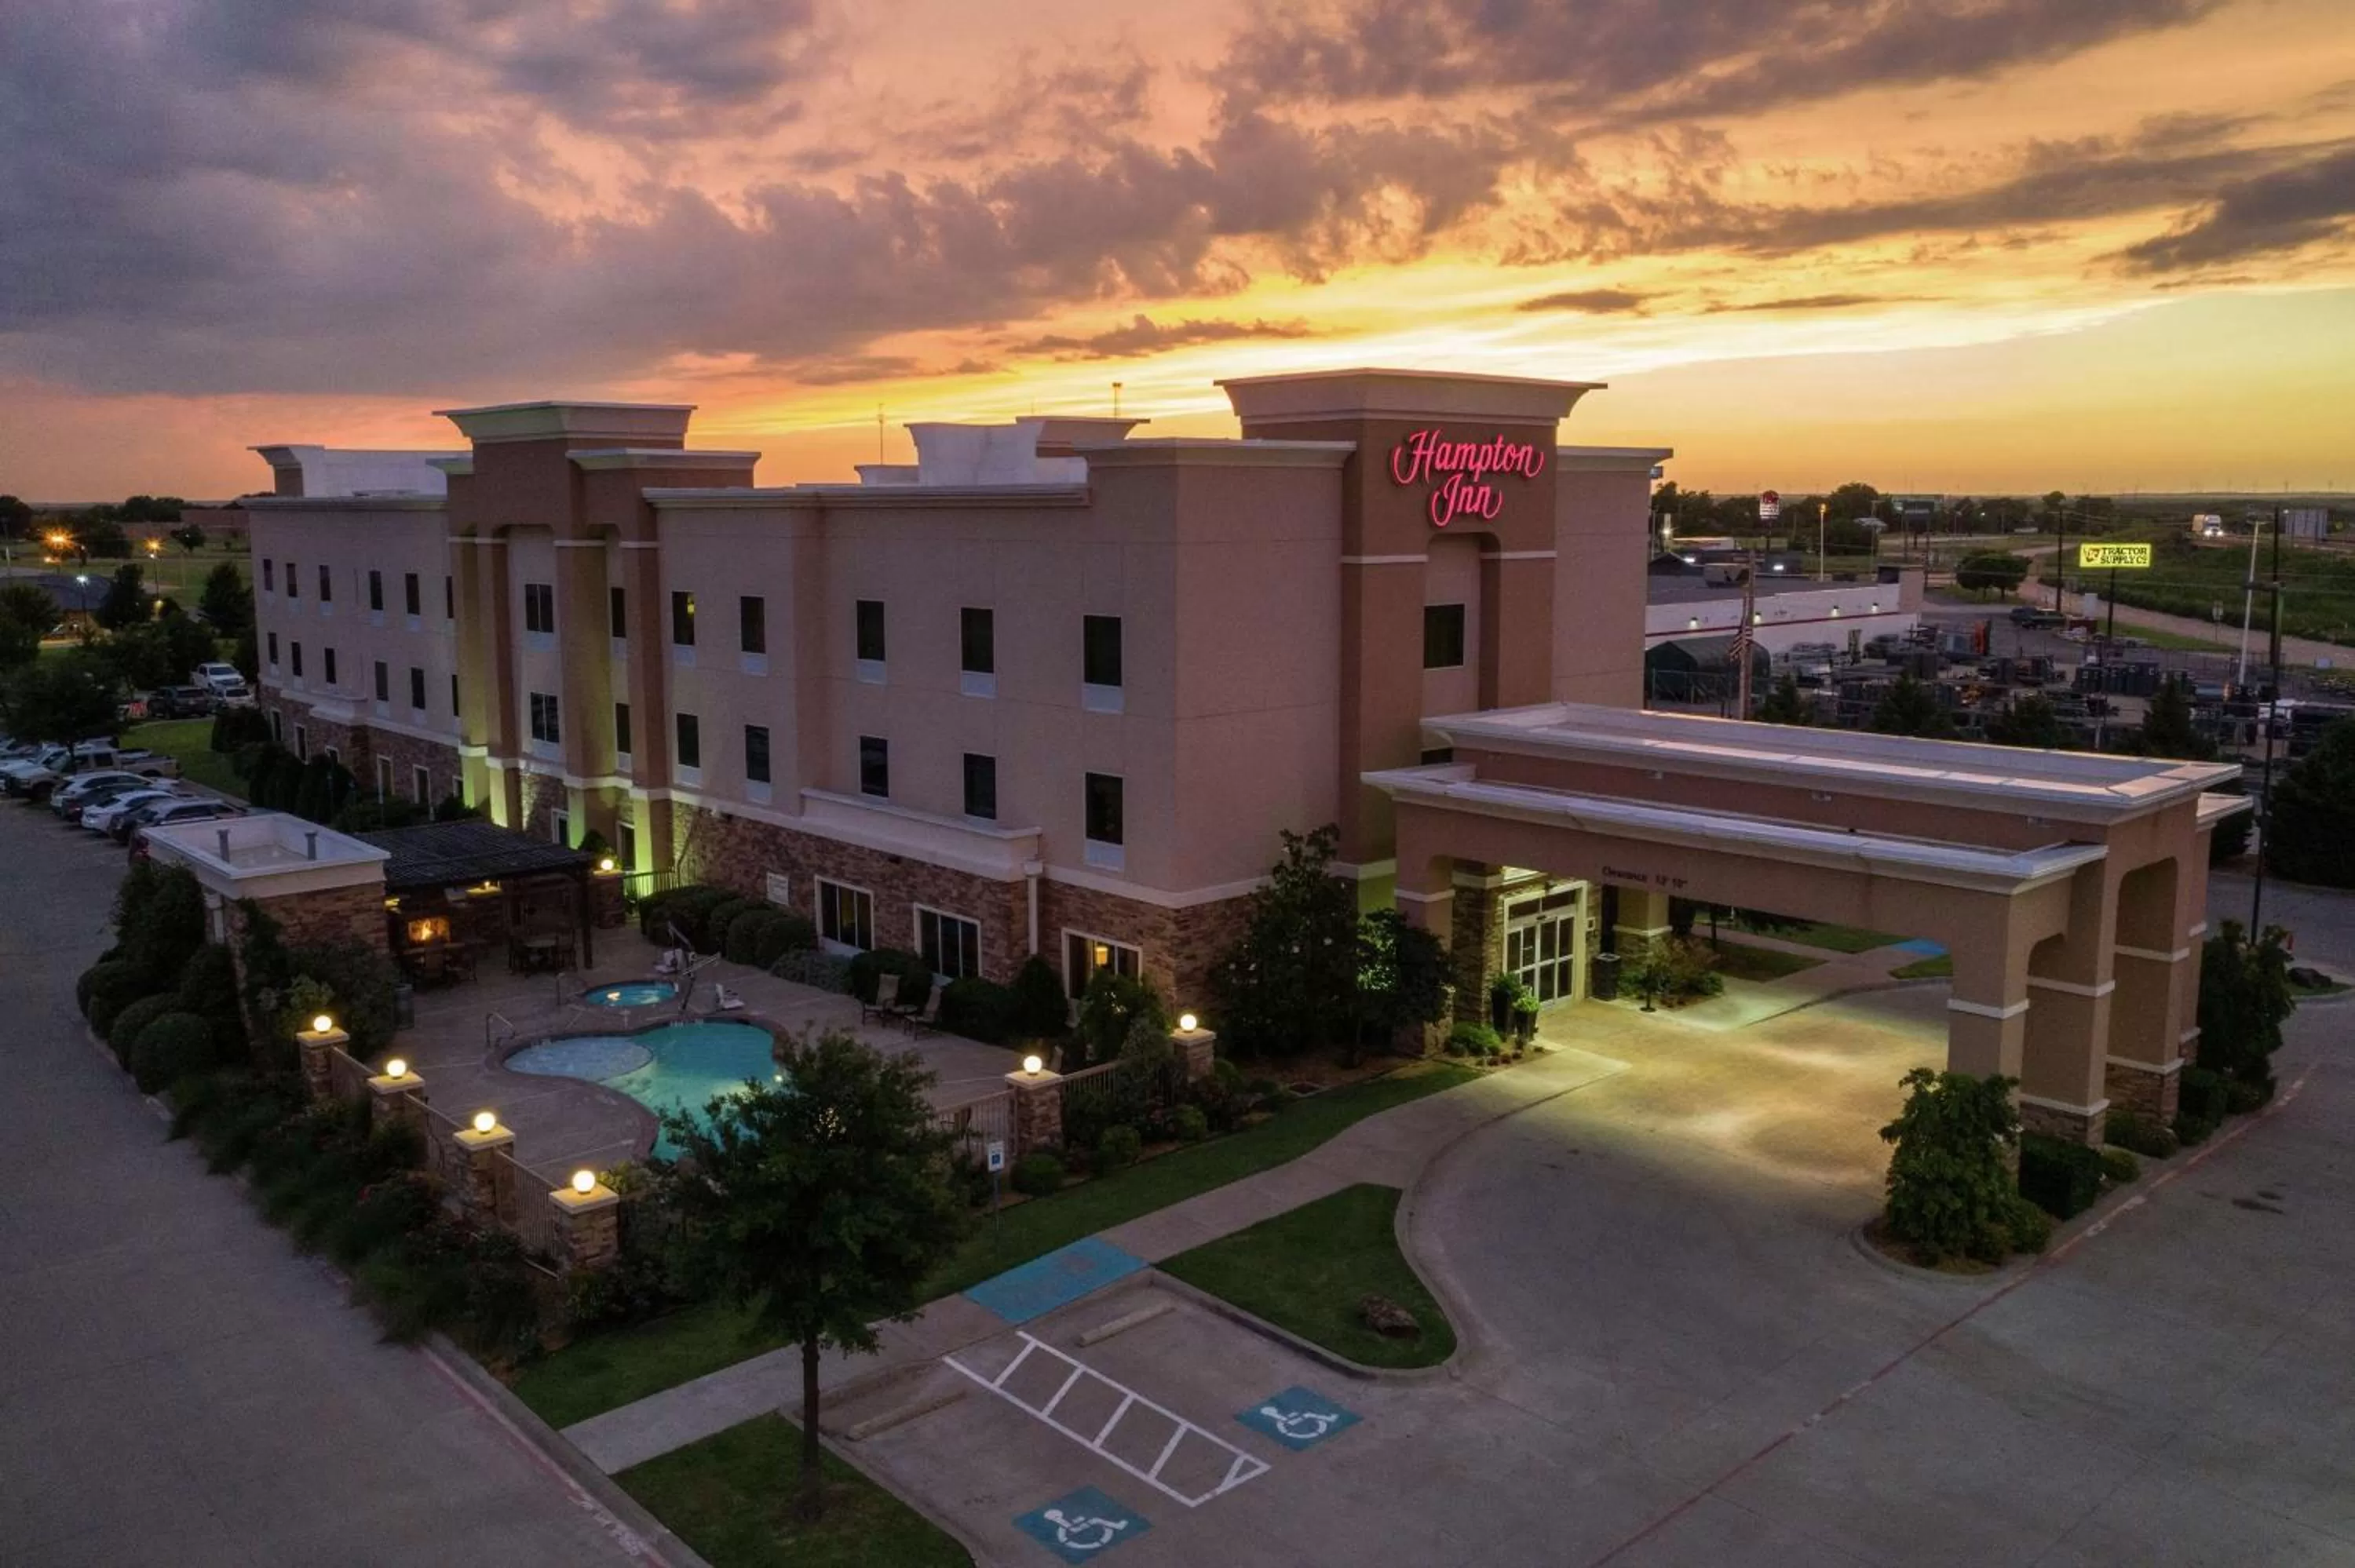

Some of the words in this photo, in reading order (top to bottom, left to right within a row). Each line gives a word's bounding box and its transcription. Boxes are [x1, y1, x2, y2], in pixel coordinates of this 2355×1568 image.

[1393, 429, 1544, 484] Hampton
[1431, 472, 1502, 527] Inn
[2100, 556, 2135, 564] SUPPLY
[2101, 547, 2147, 556] TRACTOR
